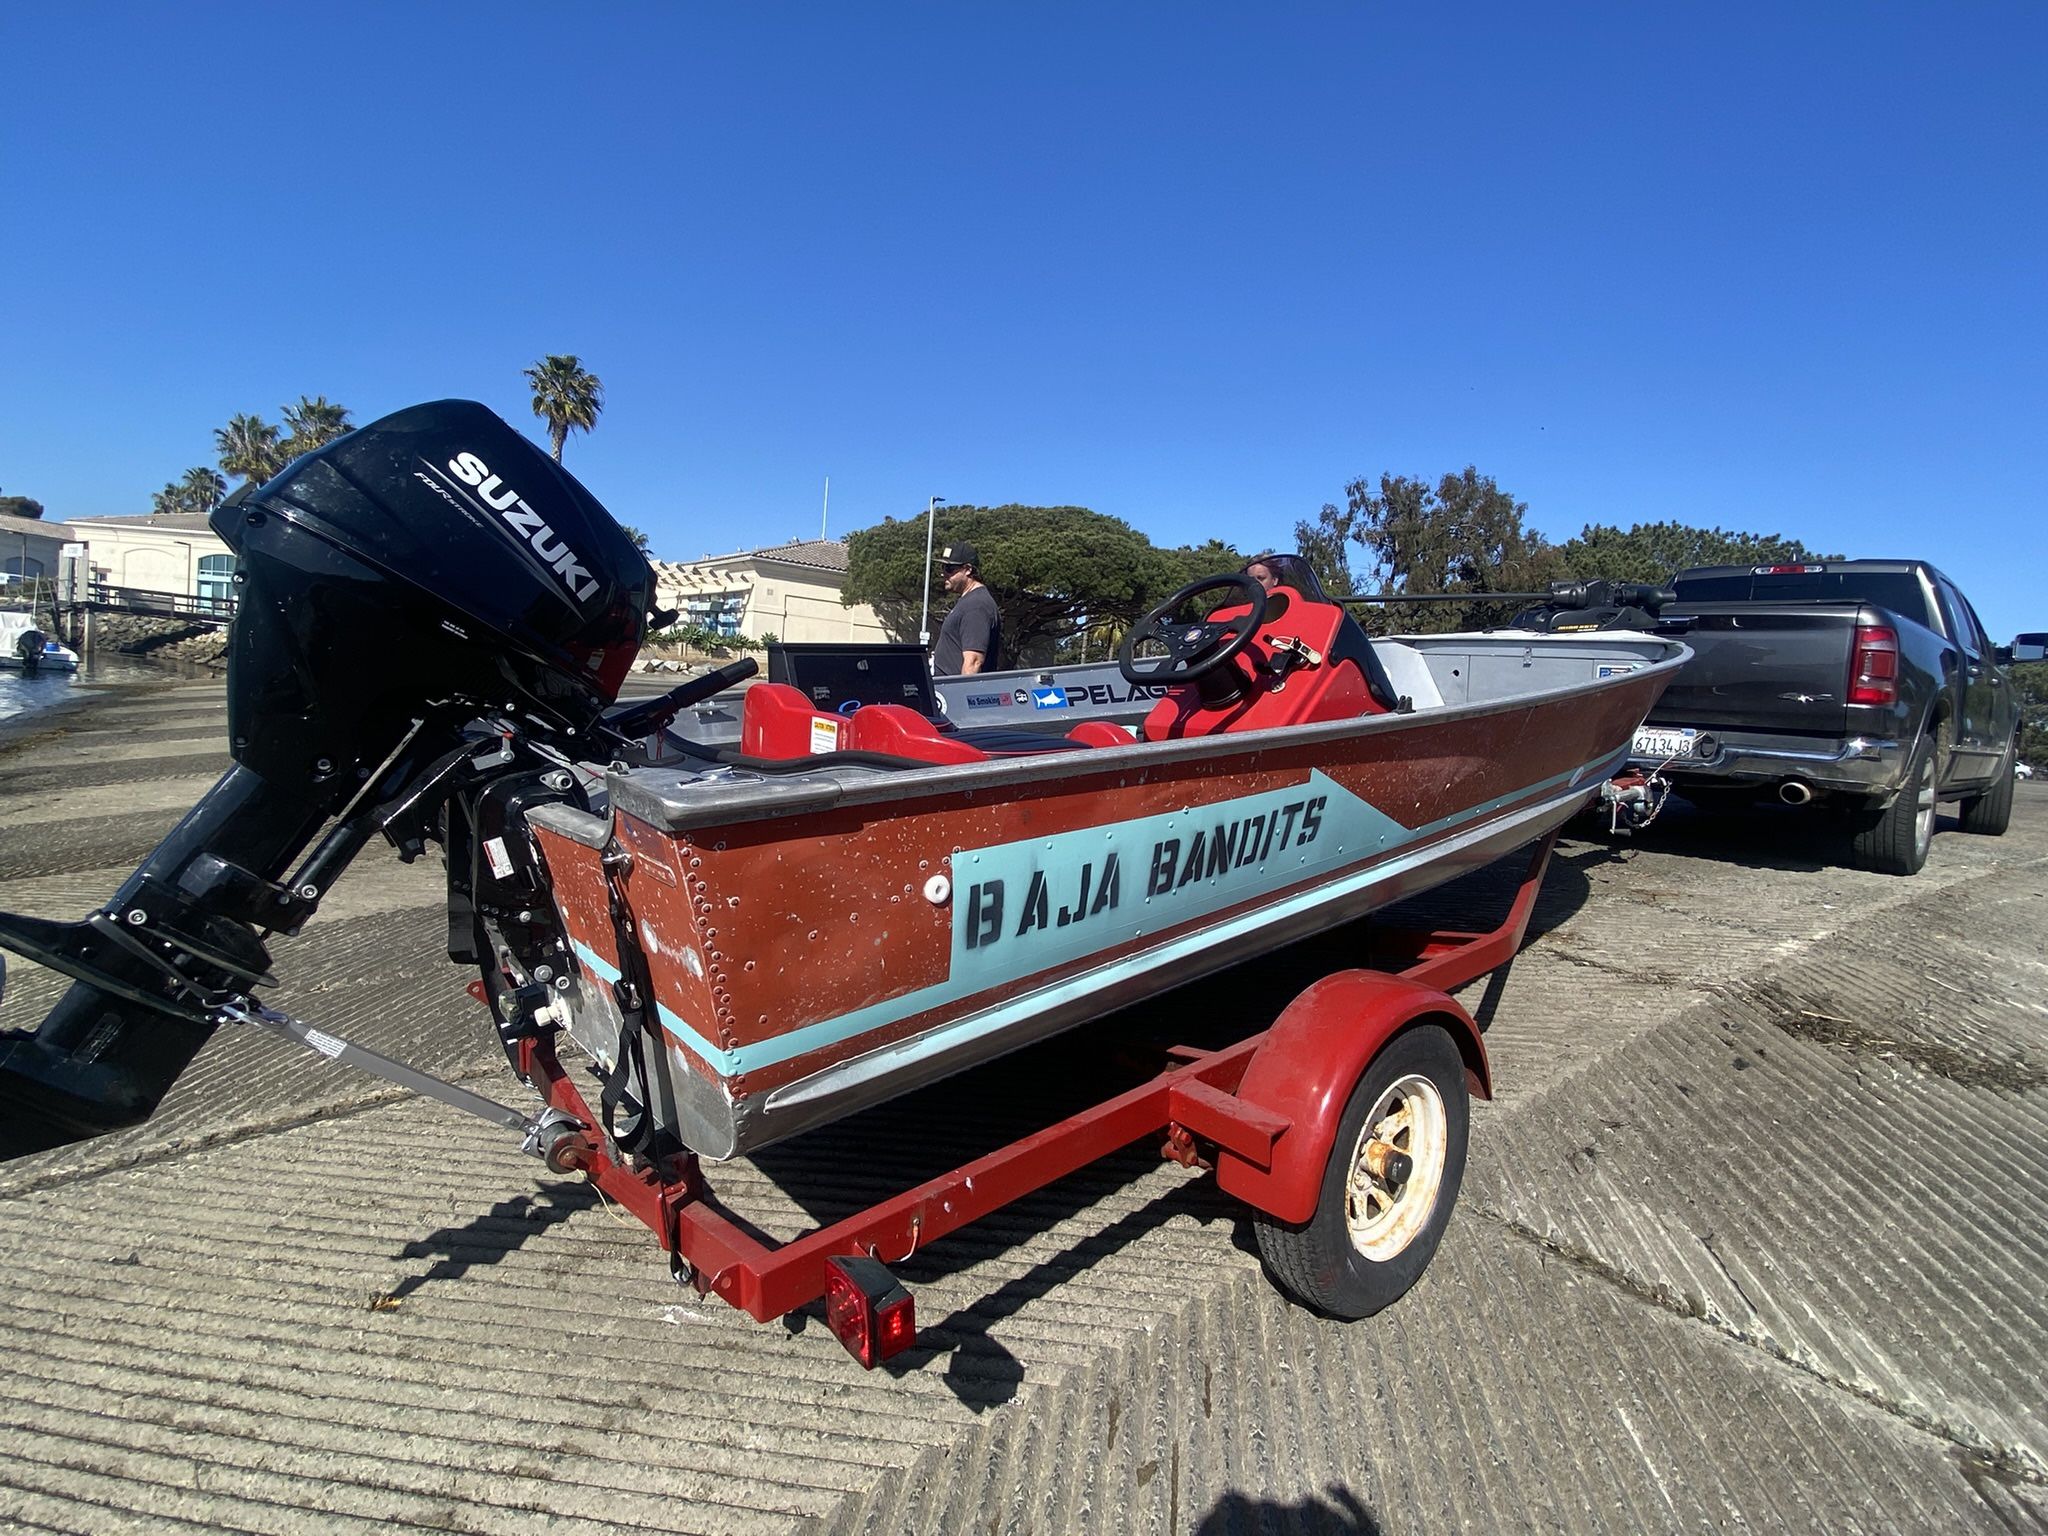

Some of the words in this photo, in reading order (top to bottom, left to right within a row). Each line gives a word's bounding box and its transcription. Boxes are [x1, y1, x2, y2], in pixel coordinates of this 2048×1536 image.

[413, 472, 452, 500] FOUR
[448, 451, 601, 603] SUZUKI
[967, 697, 976, 706] No
[976, 696, 1001, 706] Smoking
[1635, 737, 1690, 753] 67134J3
[965, 852, 1122, 950] BAJA
[1146, 796, 1328, 897] BANDITS
